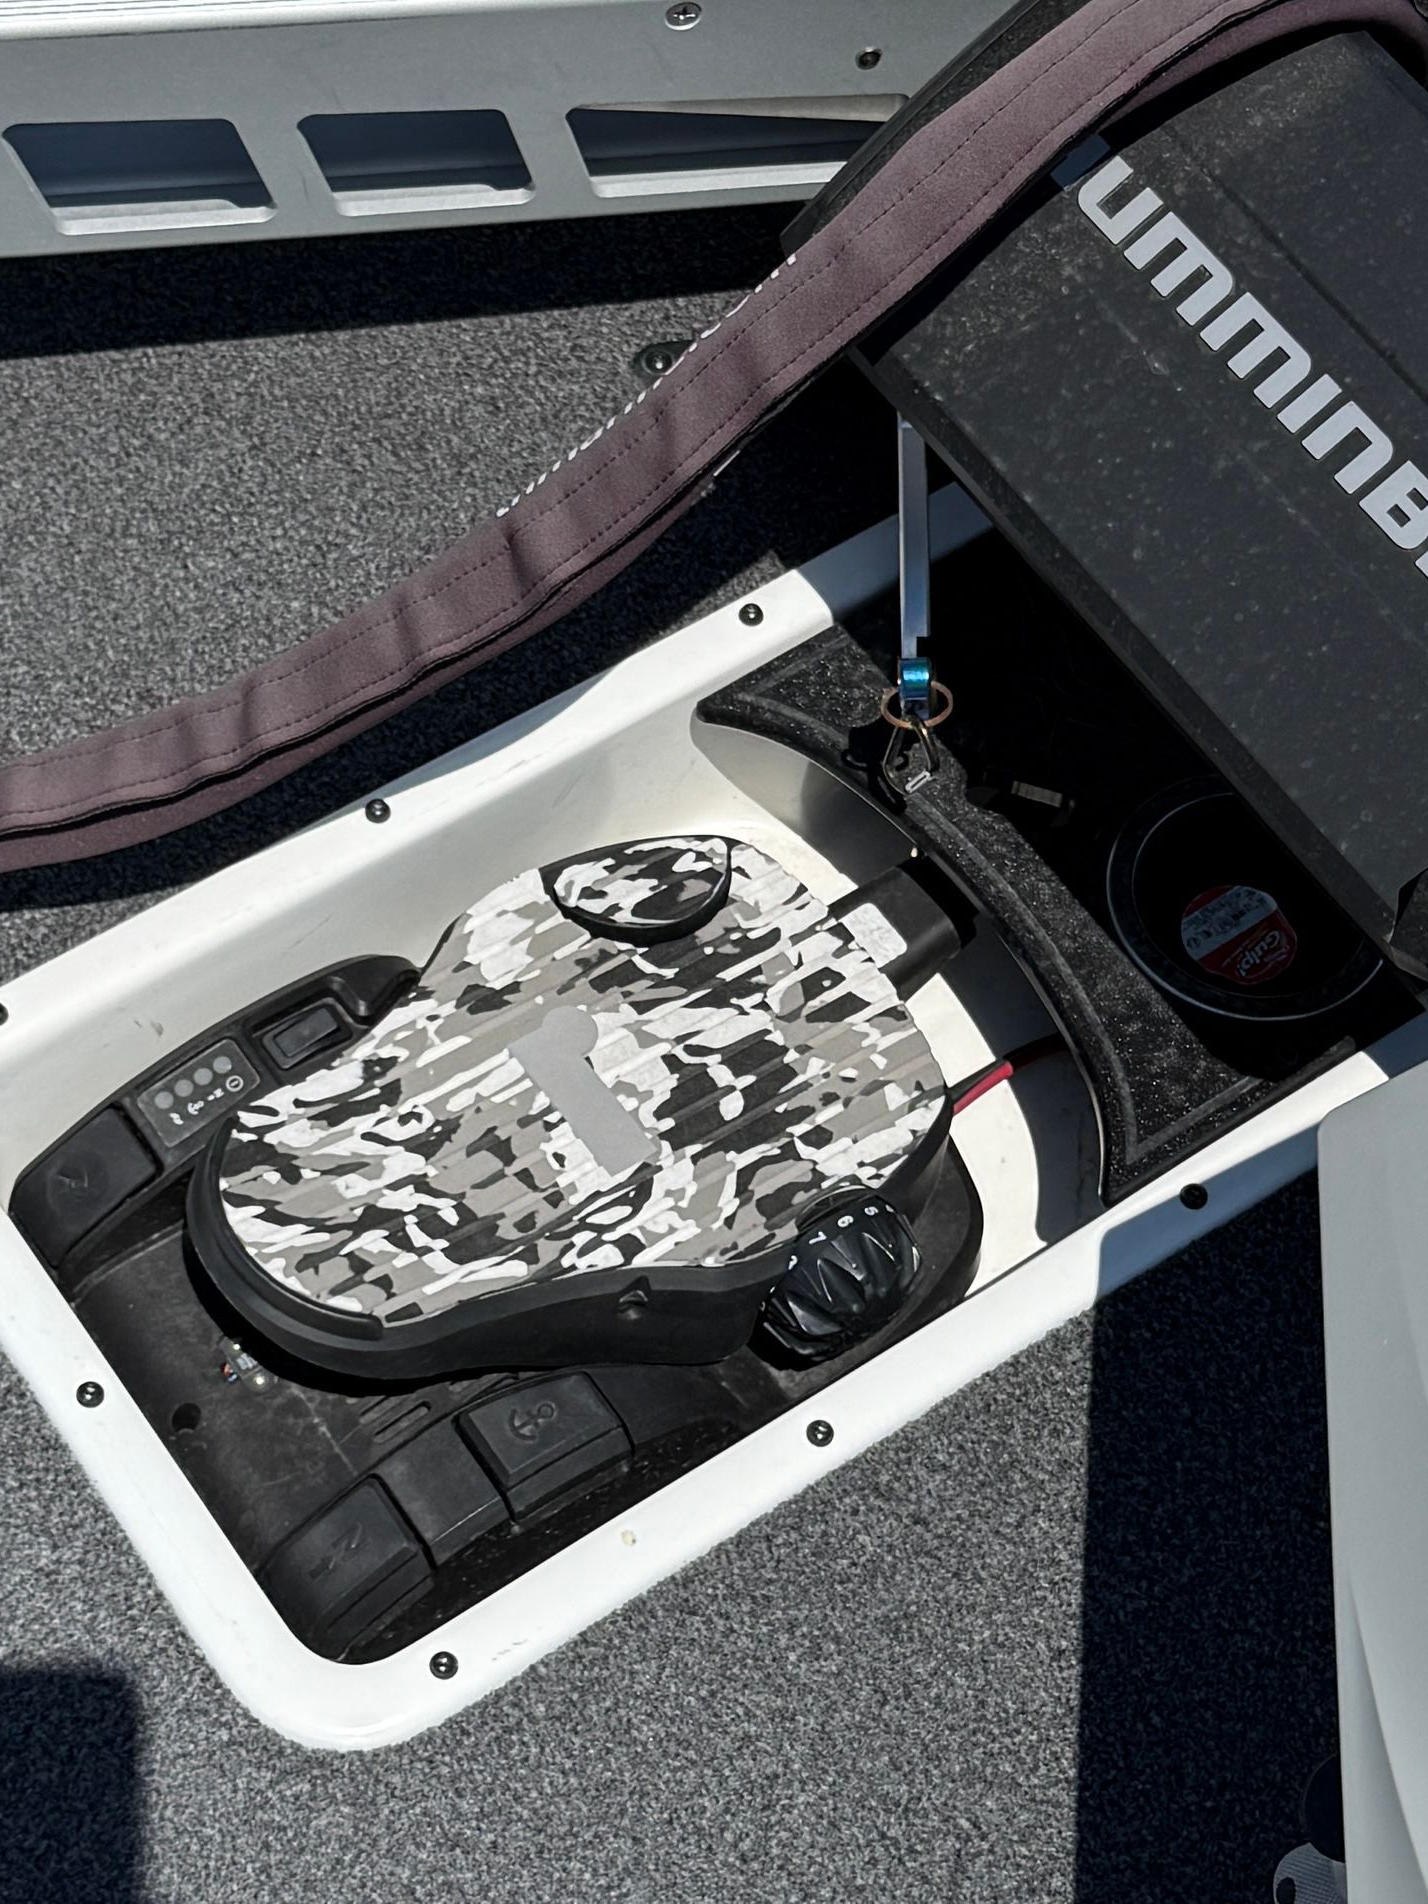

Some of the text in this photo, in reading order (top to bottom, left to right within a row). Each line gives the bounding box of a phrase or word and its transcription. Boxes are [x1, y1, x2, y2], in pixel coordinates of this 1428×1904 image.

[1235, 929, 1281, 977] Gulp!
[863, 1205, 880, 1217] 5
[837, 1214, 855, 1228] 6
